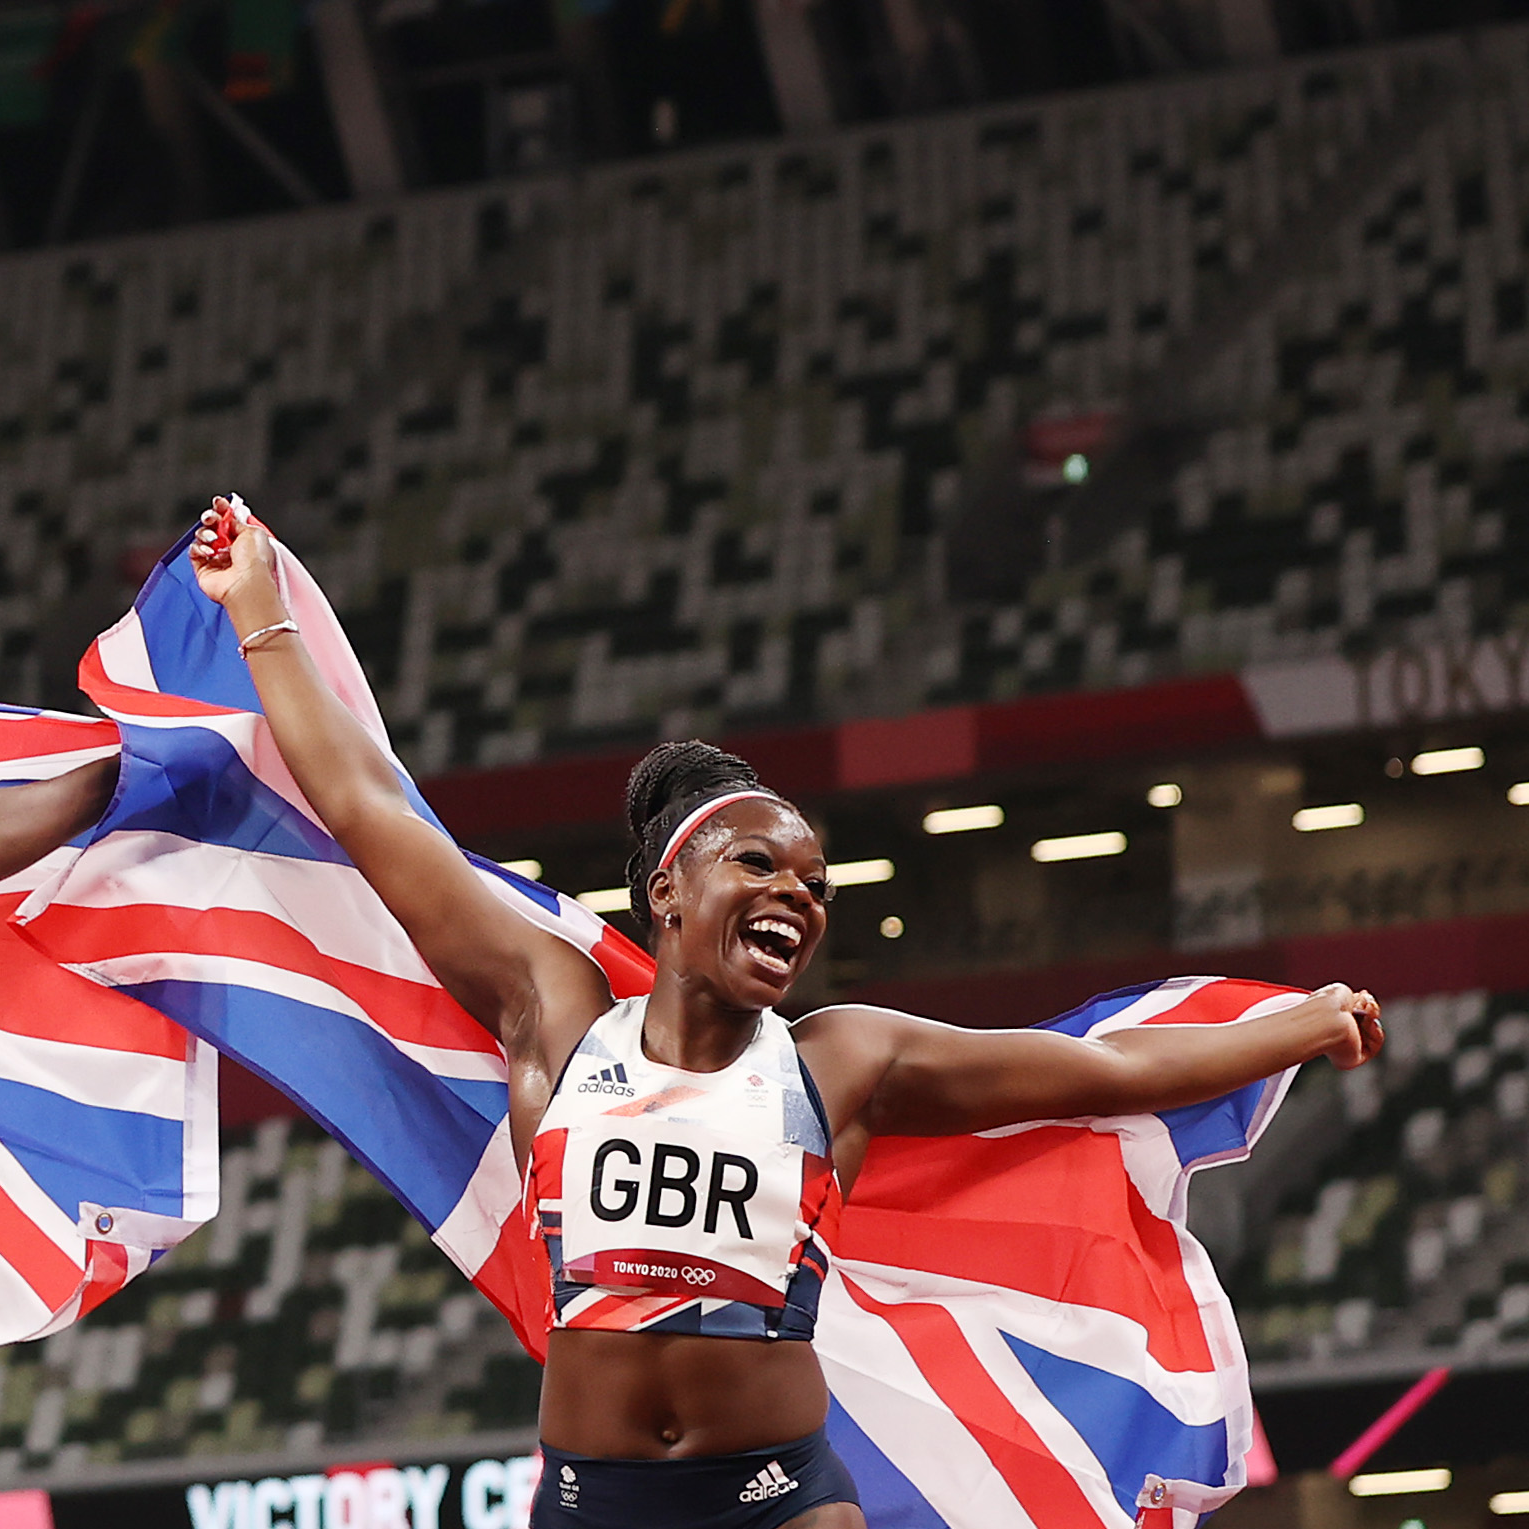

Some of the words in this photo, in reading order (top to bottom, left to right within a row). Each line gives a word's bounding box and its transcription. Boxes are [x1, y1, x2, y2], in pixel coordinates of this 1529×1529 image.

[577, 1079, 635, 1098] adidas
[590, 1138, 759, 1240] GBR
[613, 1261, 649, 1276] TOKYO
[650, 1265, 678, 1279] 2020
